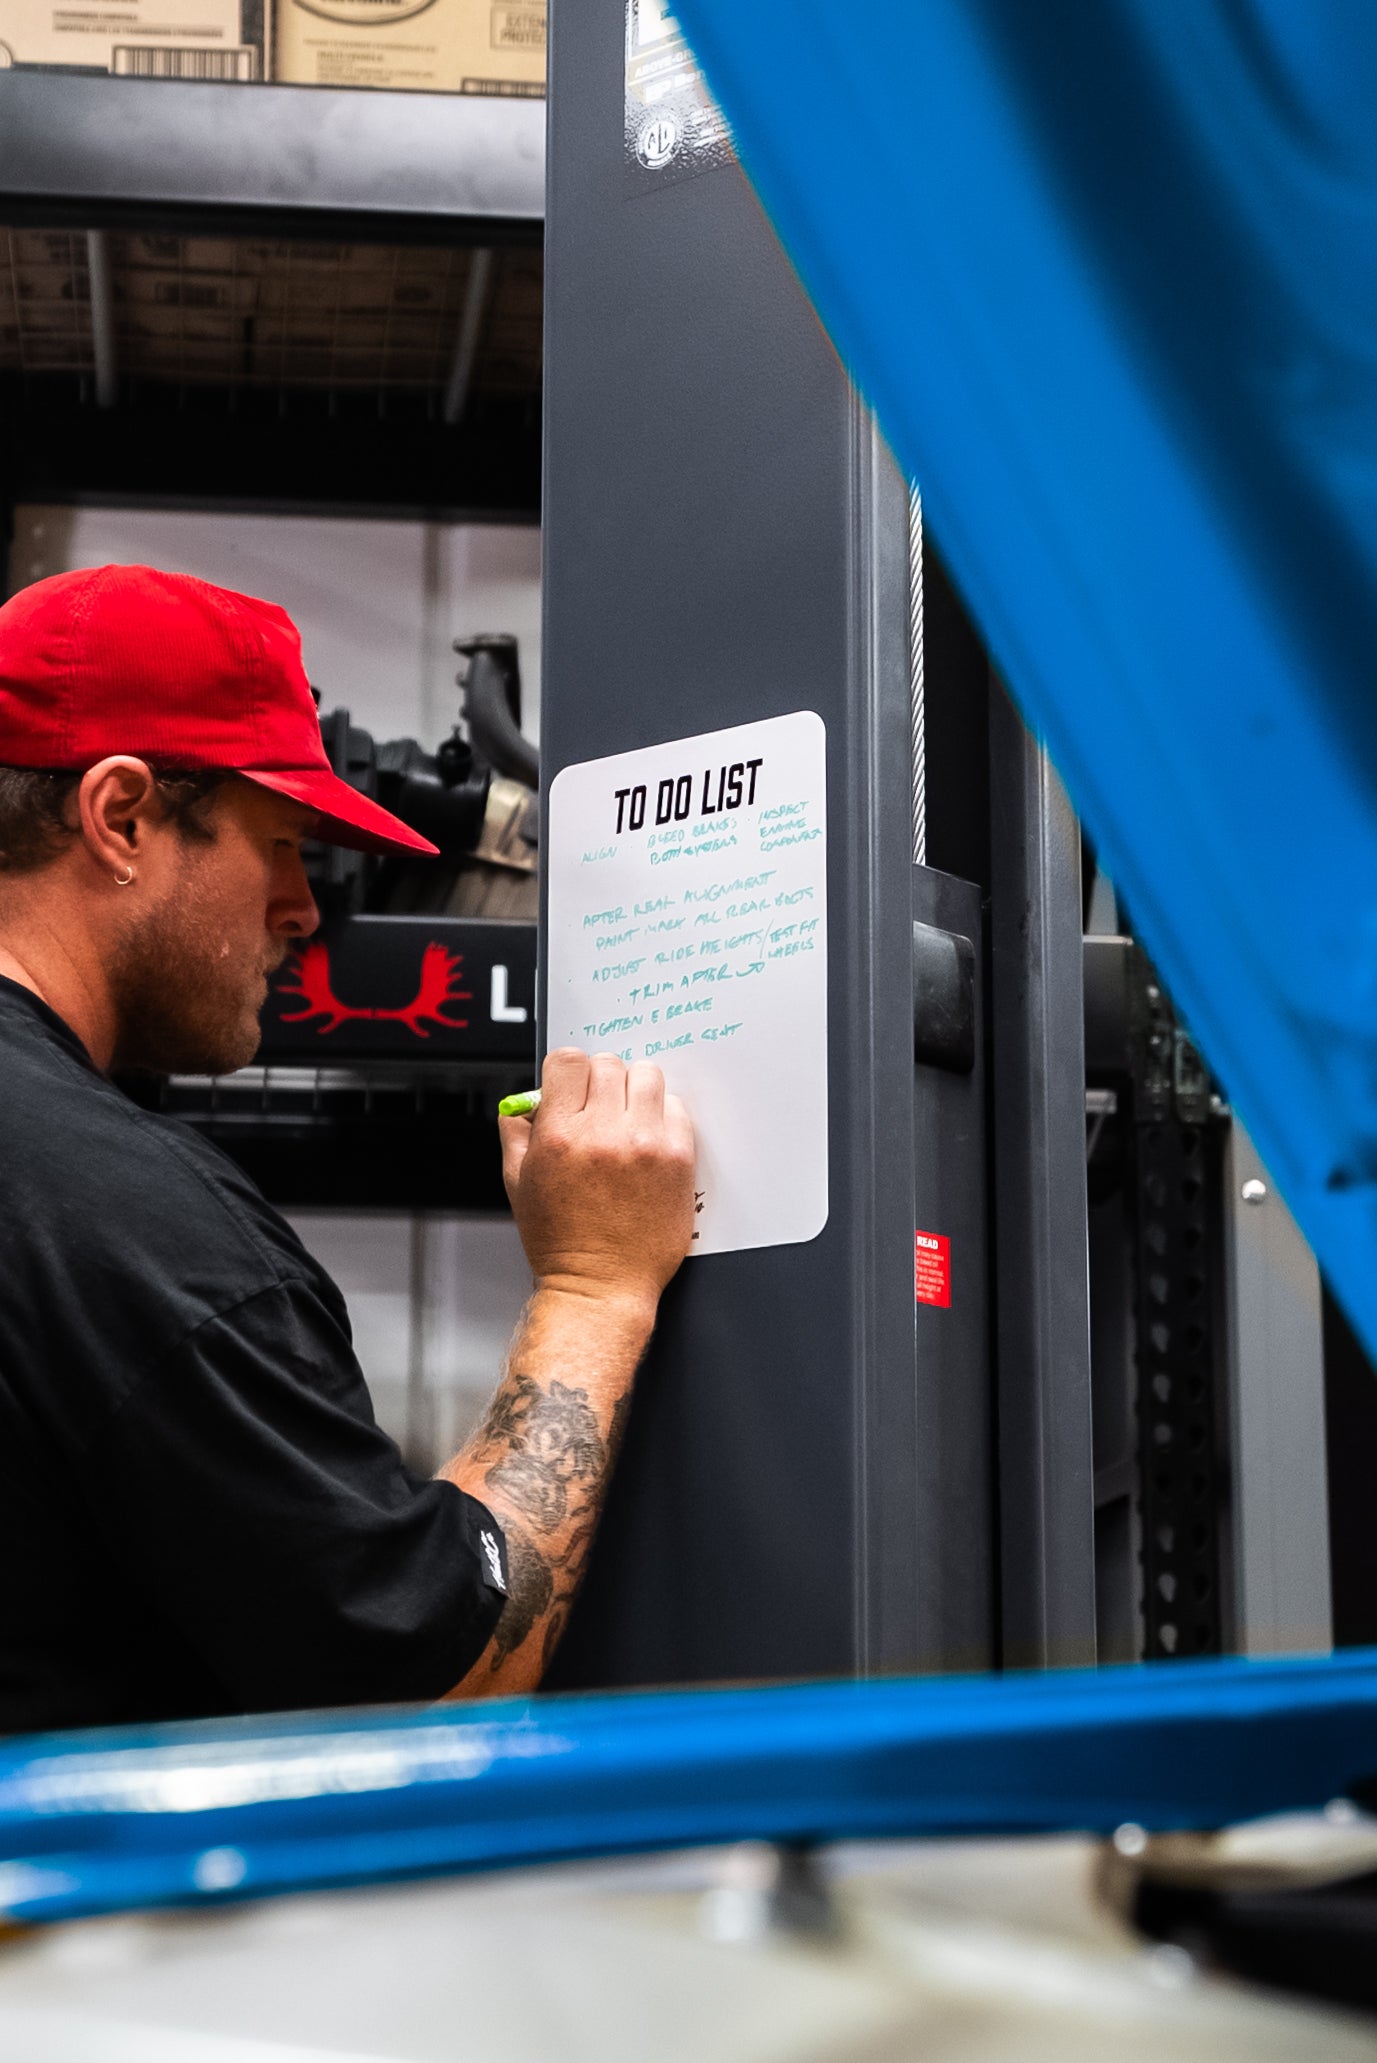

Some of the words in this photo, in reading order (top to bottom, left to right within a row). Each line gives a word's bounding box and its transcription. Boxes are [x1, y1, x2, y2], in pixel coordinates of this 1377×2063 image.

[614, 785, 647, 834] TO
[656, 775, 692, 826] DO
[701, 758, 763, 816] LIST
[582, 846, 617, 866] ALIGN
[693, 912, 721, 929] ALL
[591, 958, 647, 983] ADJUST
[655, 941, 695, 965] RIDE
[490, 964, 537, 1022] L
[629, 982, 675, 1005] TRIM
[583, 1014, 644, 1037] TIGHTEN
[651, 1009, 660, 1024] E
[666, 997, 713, 1020] BRAKE
[645, 1032, 694, 1057] DRIVER
[916, 1235, 939, 1250] READ
